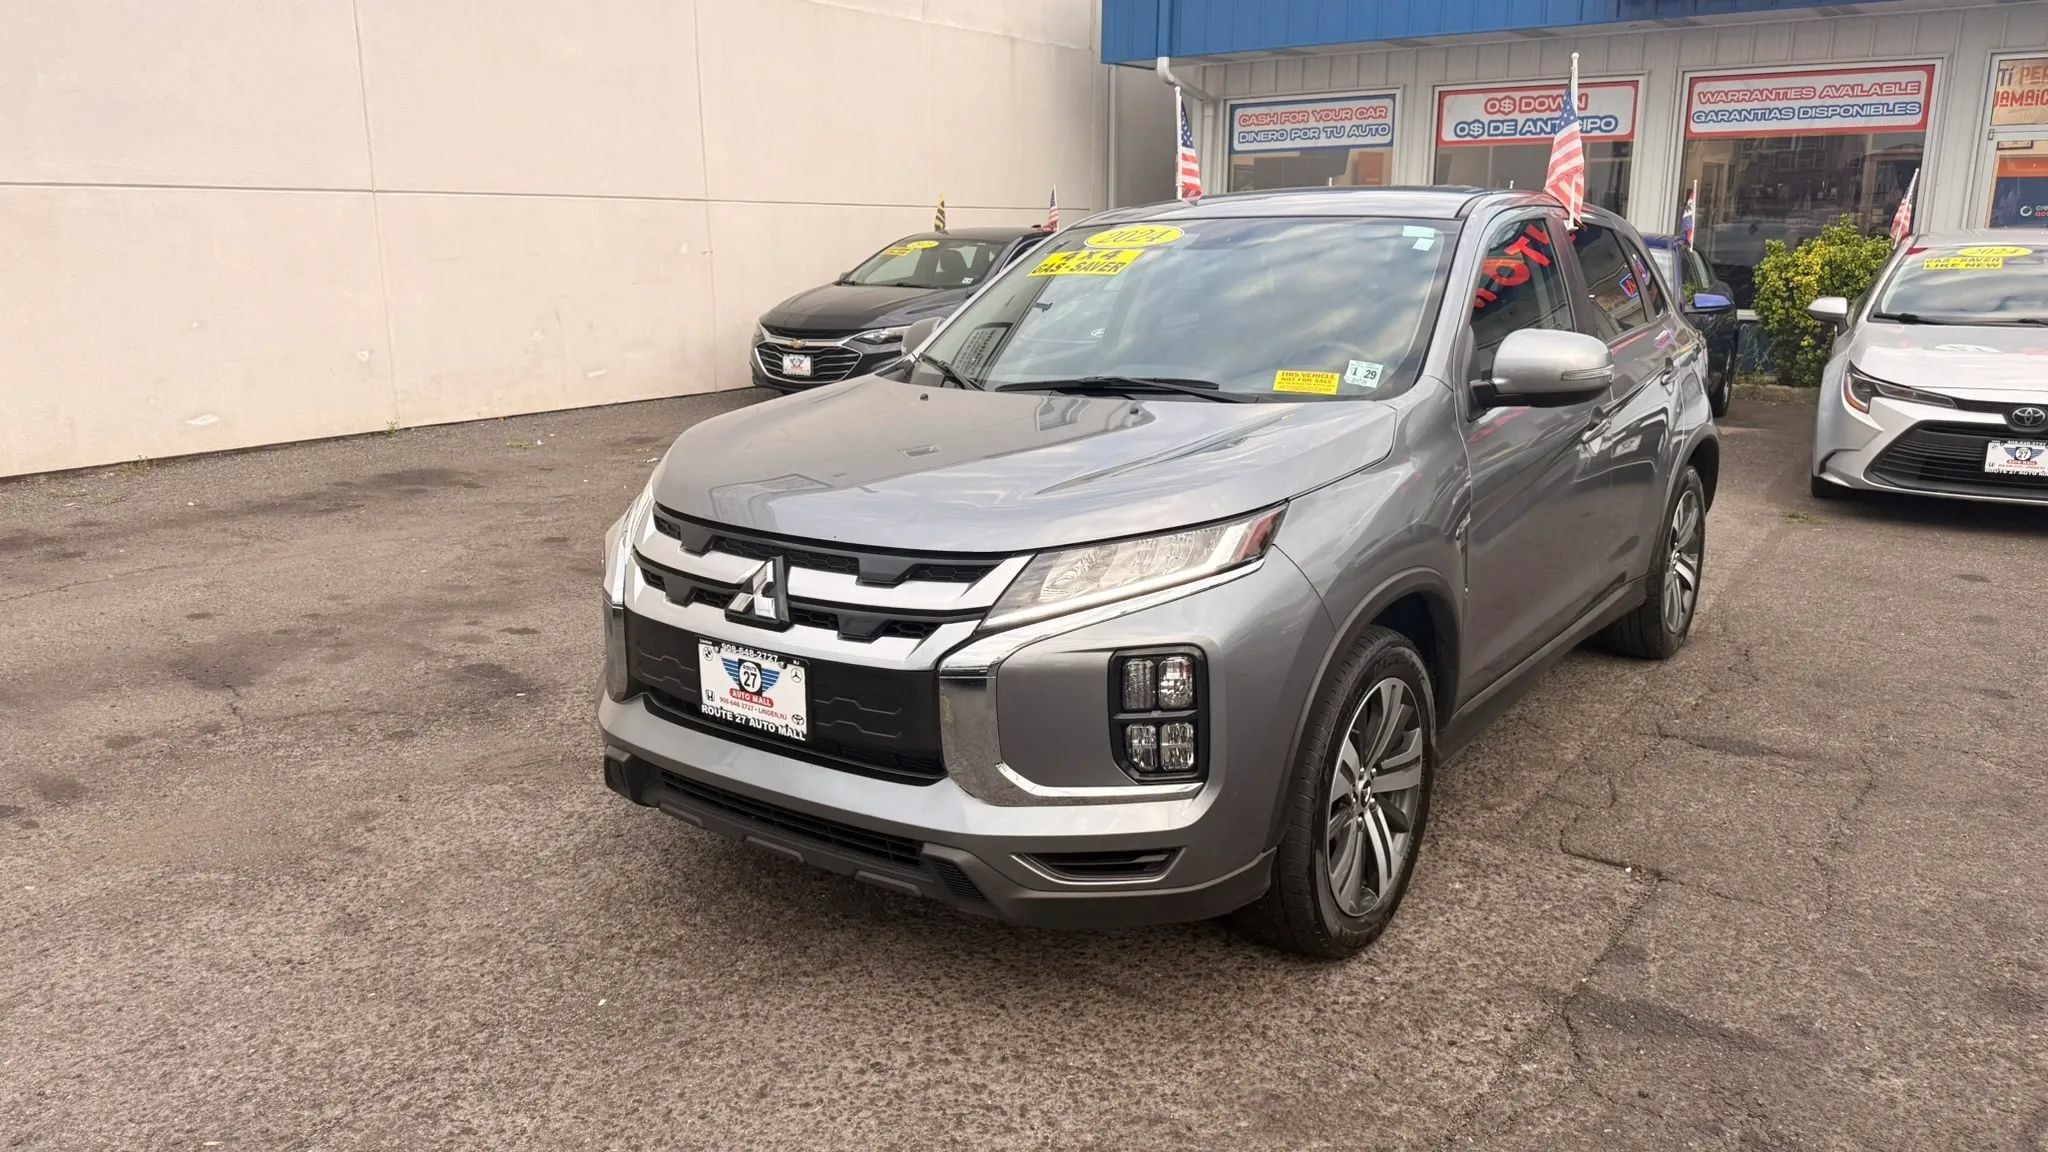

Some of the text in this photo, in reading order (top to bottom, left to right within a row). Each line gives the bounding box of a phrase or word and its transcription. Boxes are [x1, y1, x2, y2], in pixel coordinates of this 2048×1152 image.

[1698, 80, 1922, 104] WARRANTIES AVAILABLE
[1239, 106, 1388, 127] CASH FOR YOUR CAR
[1692, 101, 1922, 124] GARANTIAS DISPONIBLES
[1238, 123, 1391, 144] DINERO POR TU AUTO
[1487, 118, 1518, 137] DE
[1519, 115, 1618, 136] ANTIPO
[1097, 229, 1171, 244] 2024
[1363, 369, 1377, 380] 29
[743, 670, 757, 688] 27
[731, 688, 771, 707] AUTO MALL
[702, 704, 806, 741] ROUTE 27 AUTO MALL
